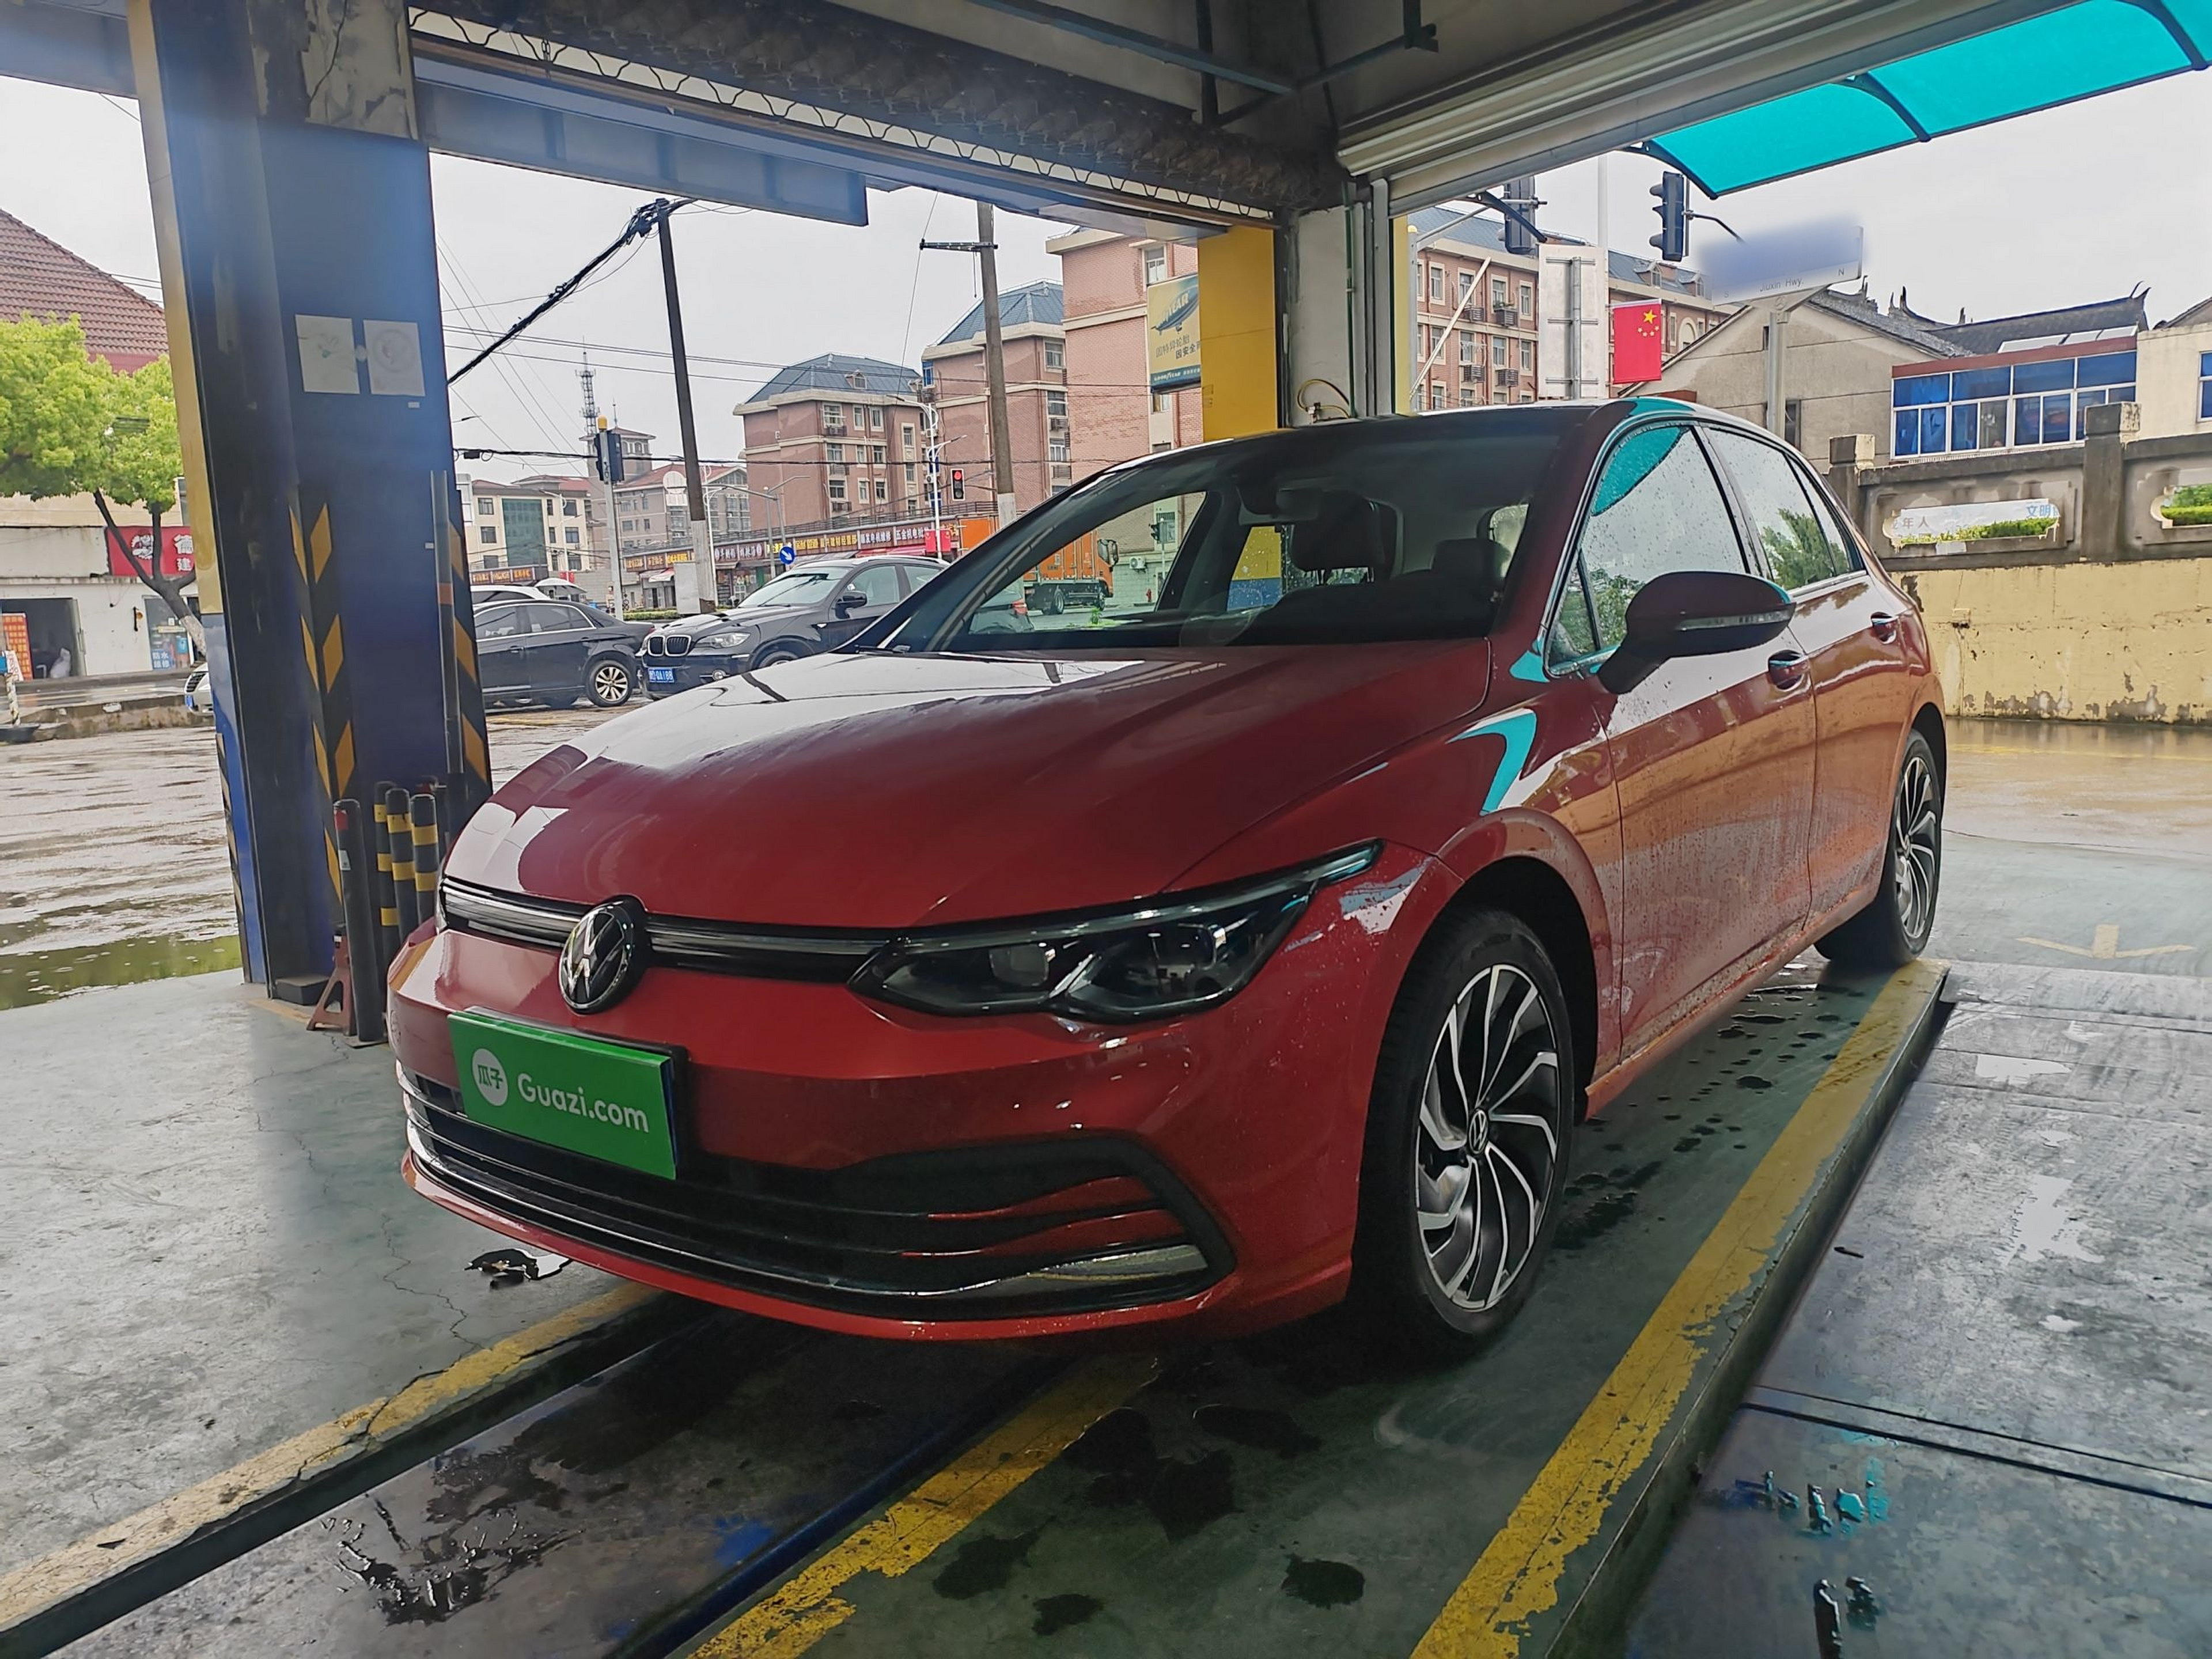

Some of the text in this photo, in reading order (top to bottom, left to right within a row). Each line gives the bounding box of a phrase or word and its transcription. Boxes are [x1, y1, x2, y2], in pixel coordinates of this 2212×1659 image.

[1759, 278, 1804, 292] Jiuxin Hwy.
[896, 527, 930, 540] 五金机电批
[477, 1065, 503, 1089] 瓜子
[518, 1073, 649, 1133] Guazi.com
